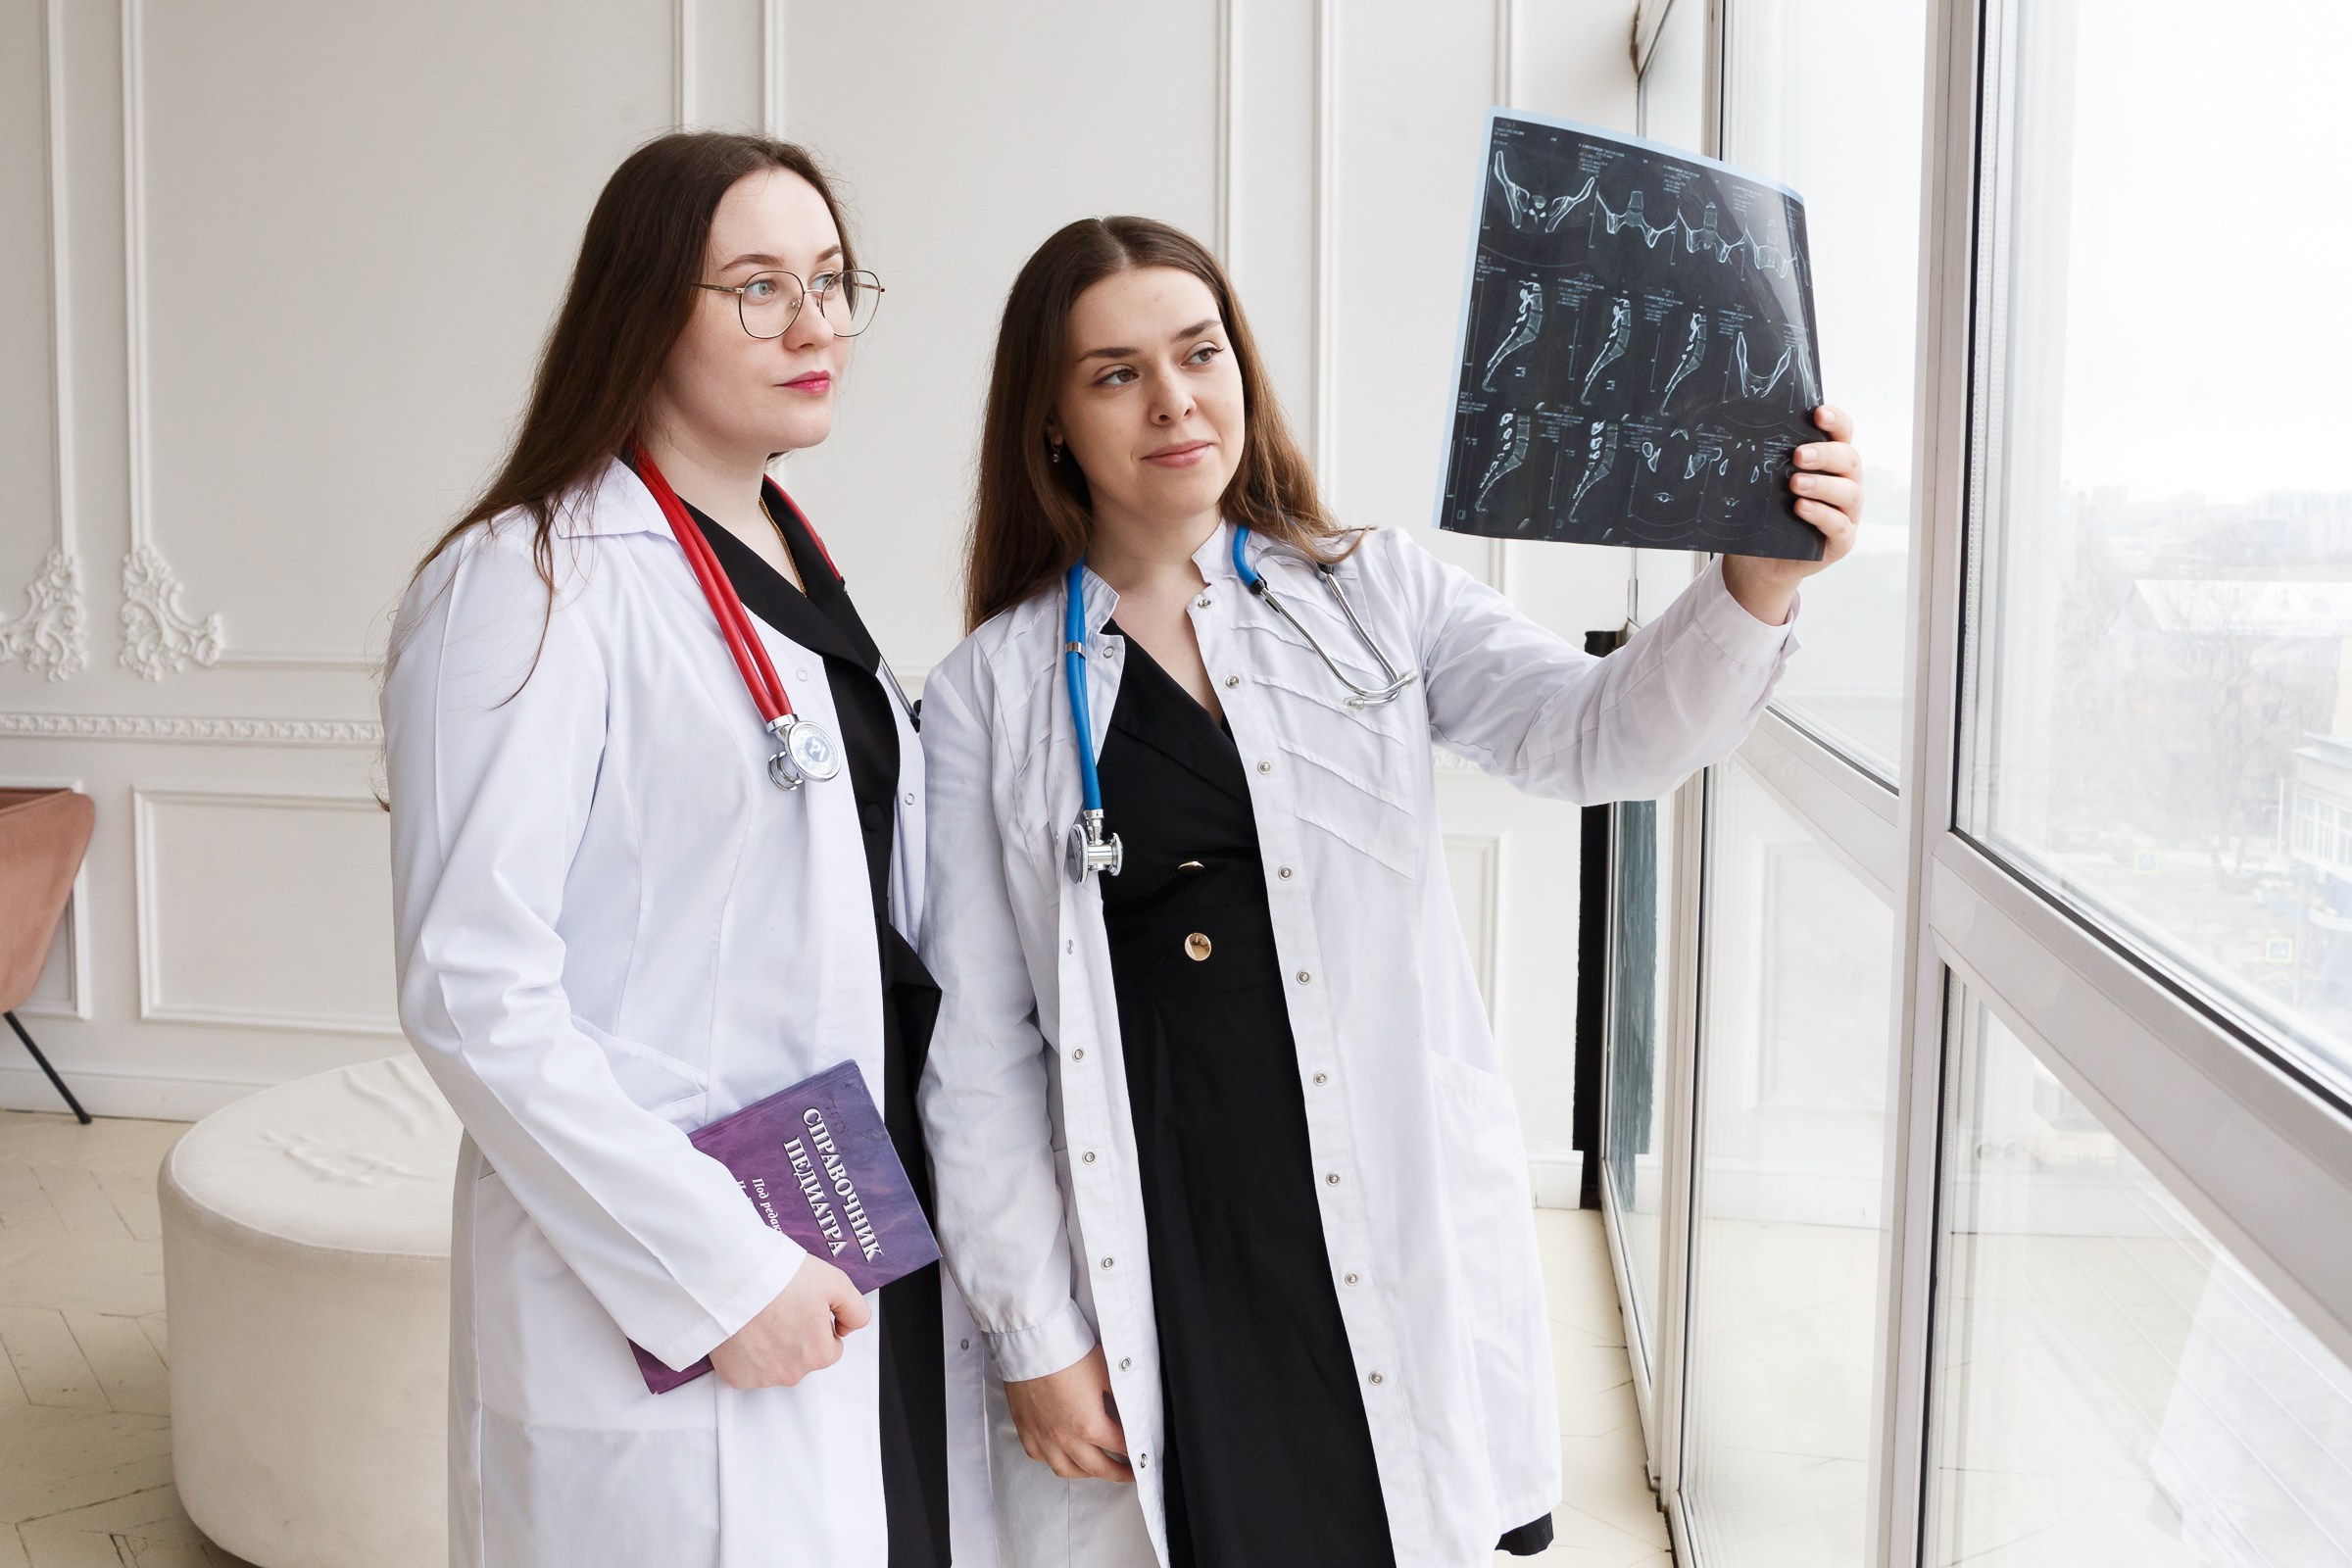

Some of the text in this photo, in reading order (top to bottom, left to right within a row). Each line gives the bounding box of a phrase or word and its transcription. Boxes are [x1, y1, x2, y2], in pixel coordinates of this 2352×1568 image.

[752, 1178, 769, 1200] Под
[783, 1136, 848, 1258] ПЕДИАТРА
[803, 1107, 884, 1263] СПРАВОЧНИК
